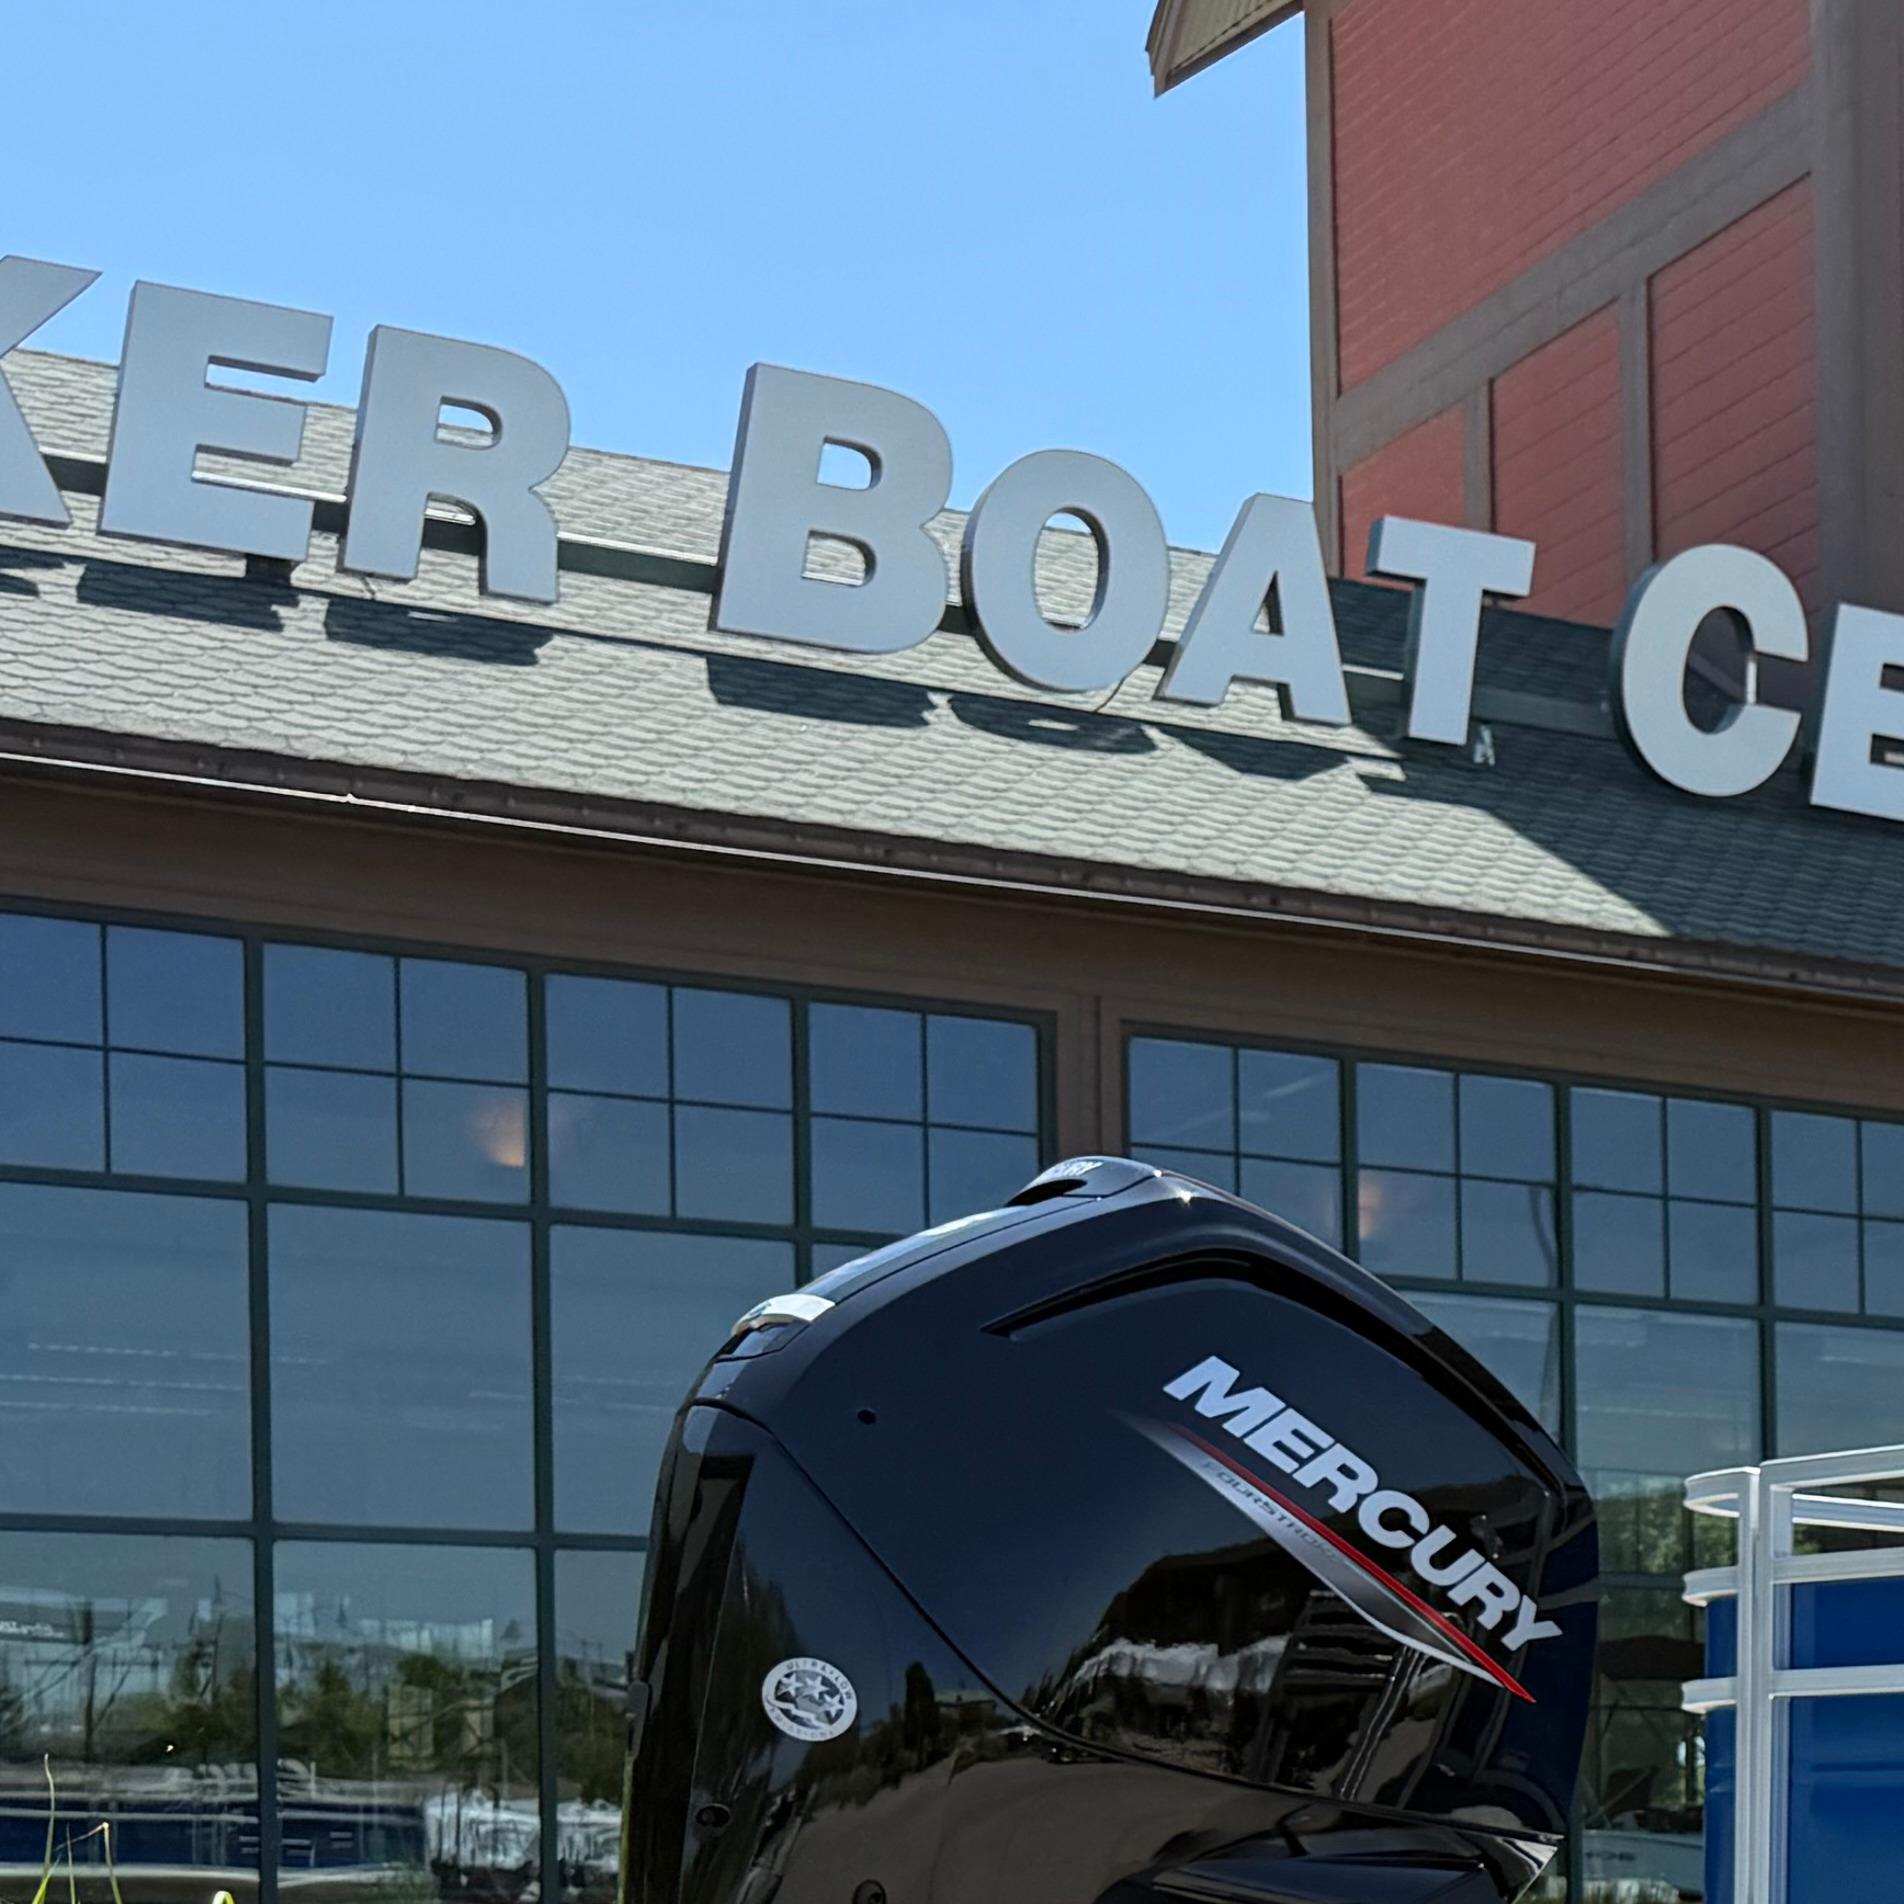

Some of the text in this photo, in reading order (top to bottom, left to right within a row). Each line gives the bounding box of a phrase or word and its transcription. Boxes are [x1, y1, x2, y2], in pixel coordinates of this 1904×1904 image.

[0, 254, 572, 606] ER
[709, 361, 1536, 747] BOAT
[1162, 1355, 1563, 1652] MERCURY
[1202, 1459, 1348, 1563] FOURSTROKE
